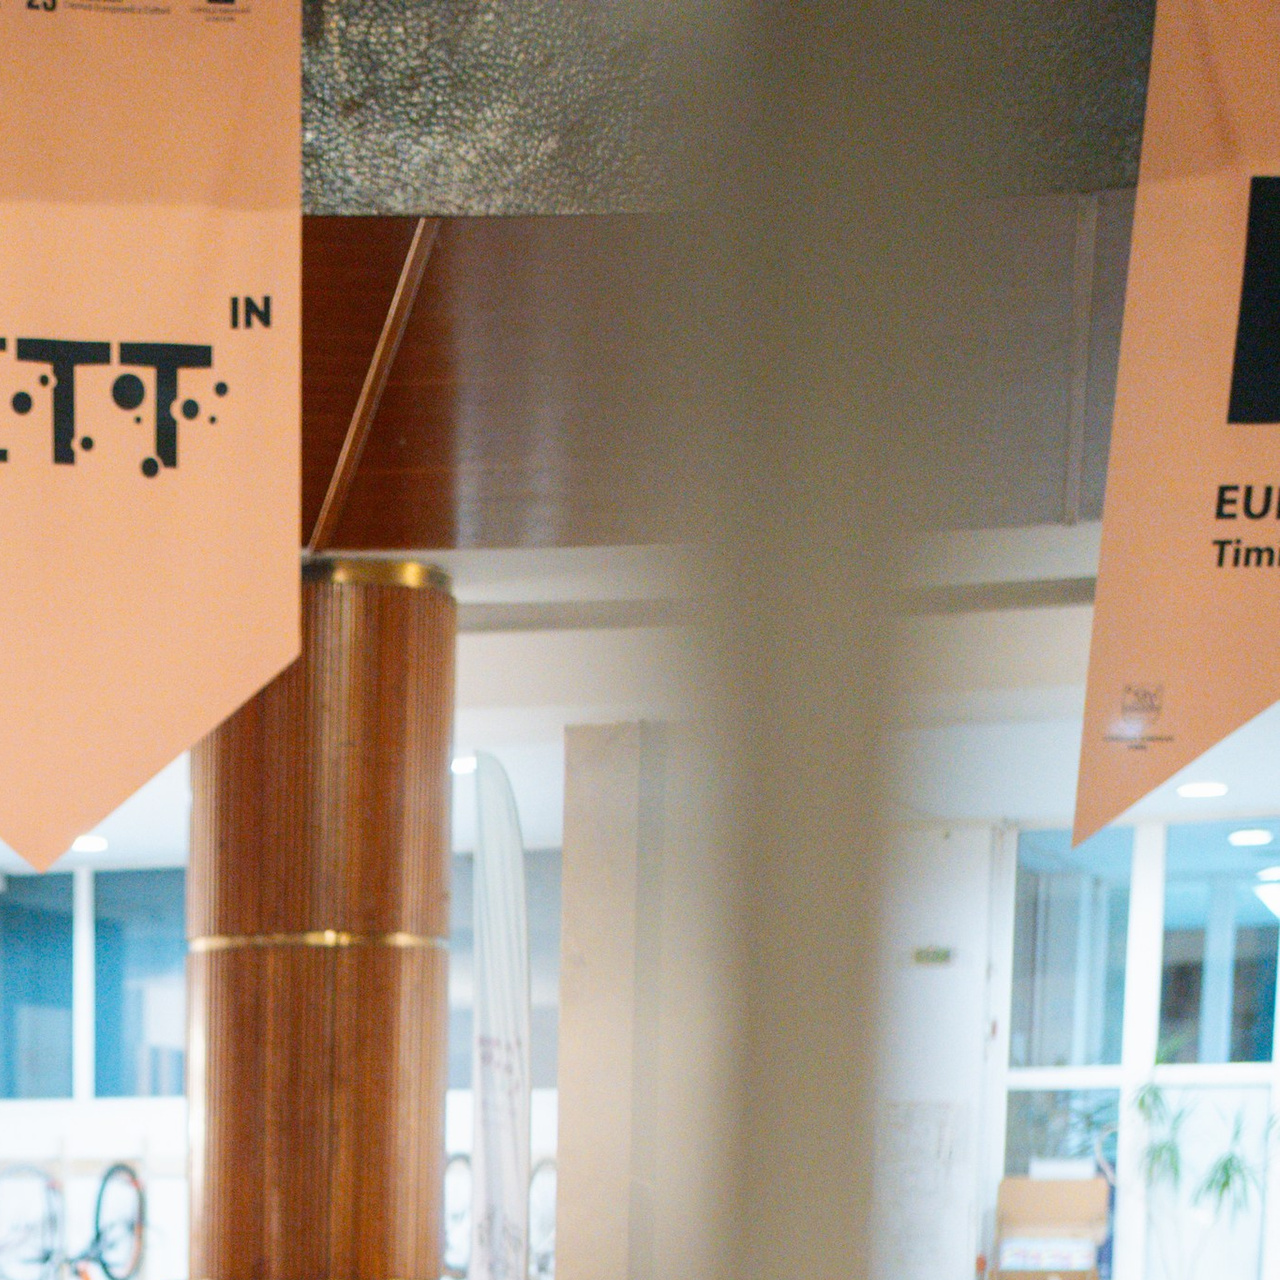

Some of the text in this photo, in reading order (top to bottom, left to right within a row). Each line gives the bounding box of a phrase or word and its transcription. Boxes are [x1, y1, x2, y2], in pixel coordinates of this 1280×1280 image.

[230, 295, 271, 329] IN
[1215, 485, 1280, 520] EU
[1212, 538, 1280, 567] Tim
